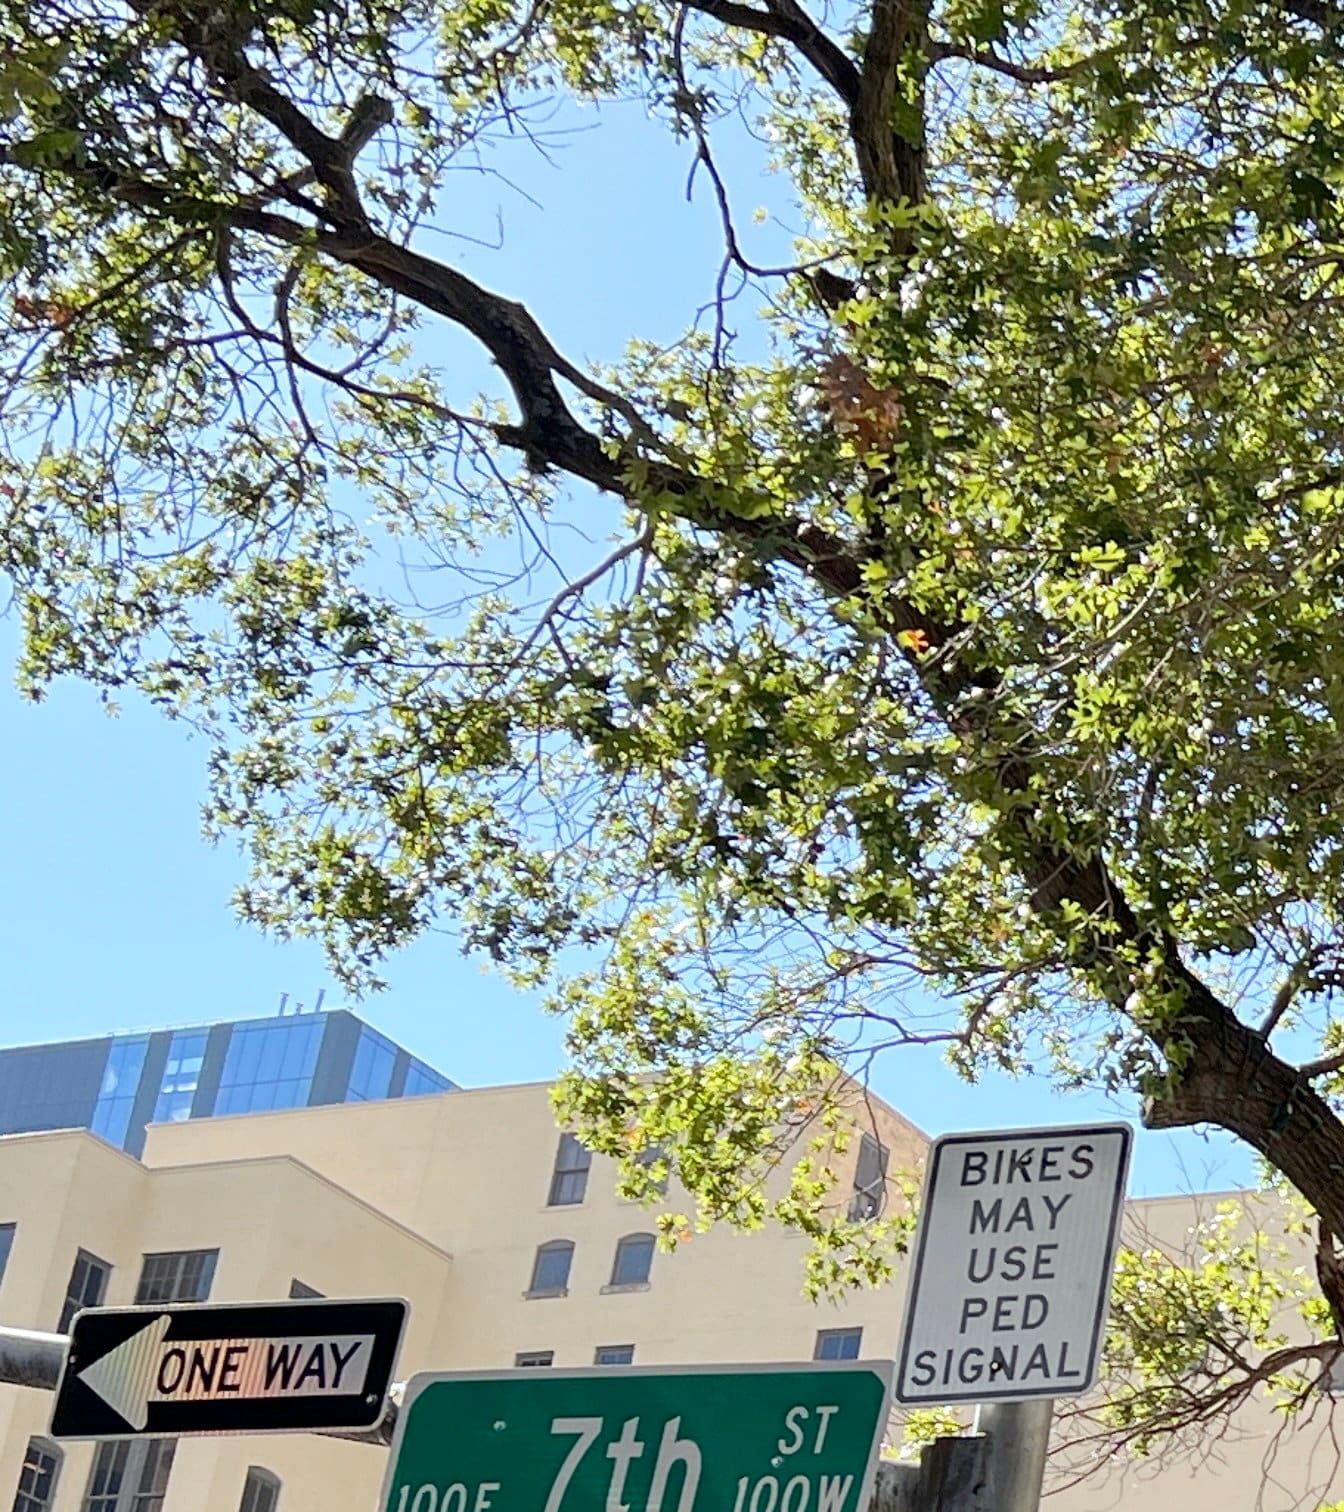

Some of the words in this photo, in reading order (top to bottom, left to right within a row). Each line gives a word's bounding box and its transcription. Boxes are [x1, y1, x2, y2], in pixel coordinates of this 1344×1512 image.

[960, 1144, 1095, 1187] BIKES
[969, 1193, 1072, 1235] MAY
[967, 1243, 1059, 1284] USE
[959, 1293, 1049, 1334] PED
[156, 1345, 249, 1395] ONE
[264, 1341, 362, 1391] WAY
[910, 1341, 1080, 1387] SIGNAL
[778, 1405, 839, 1456] ST
